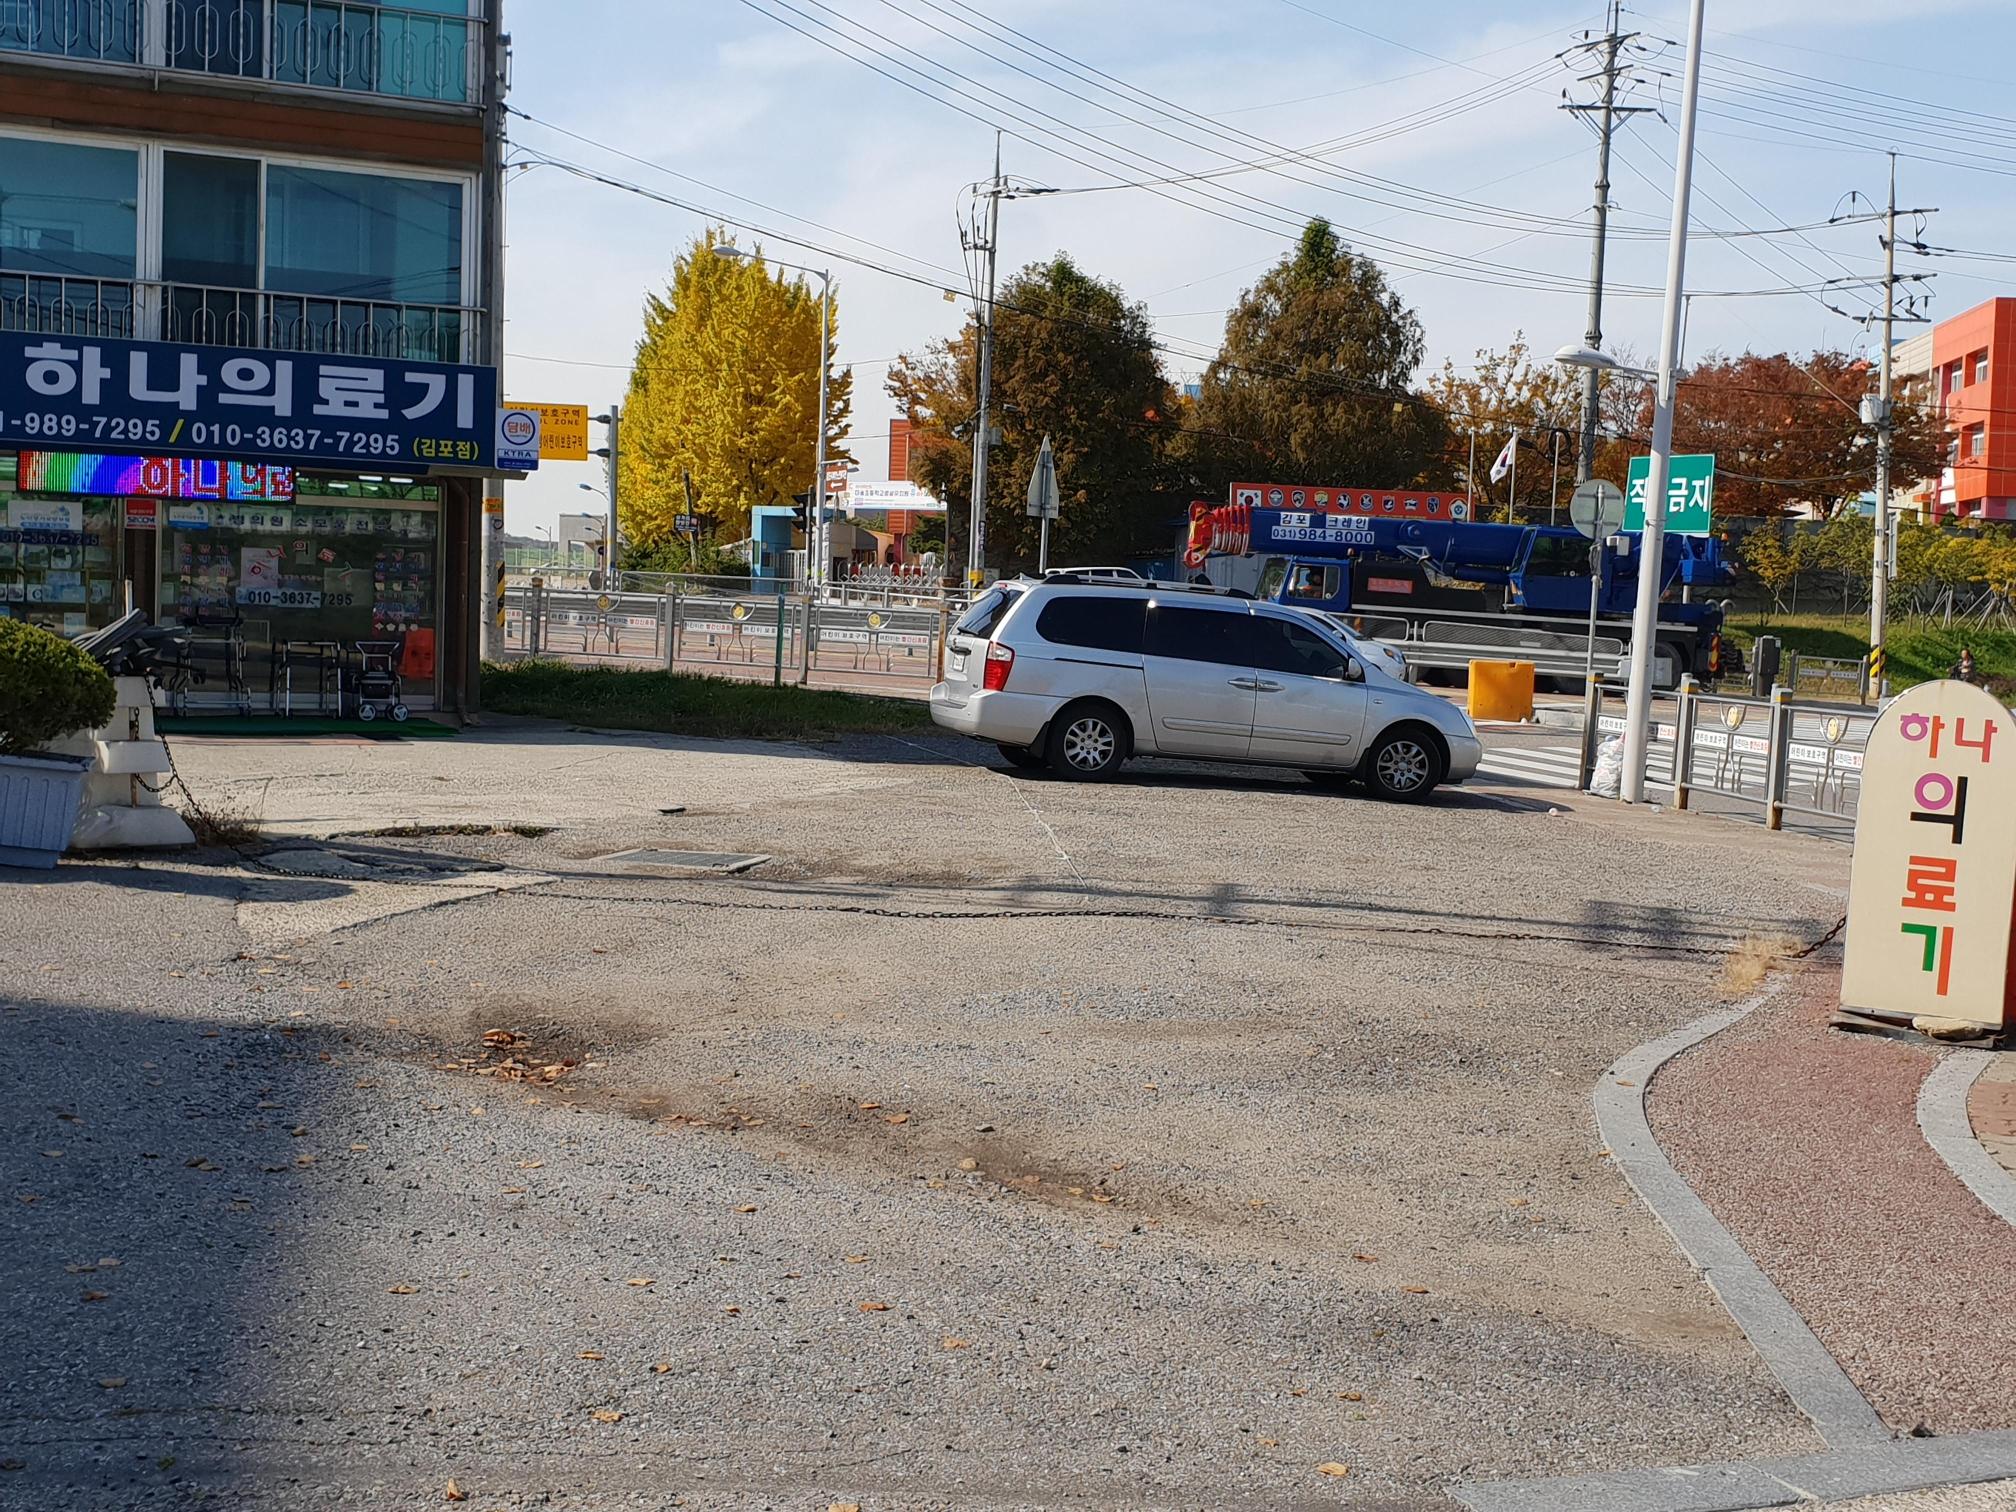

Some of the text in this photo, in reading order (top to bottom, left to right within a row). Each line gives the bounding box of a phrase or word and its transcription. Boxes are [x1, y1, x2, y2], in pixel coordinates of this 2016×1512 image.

[24, 342, 474, 429] 하나의료기
[507, 421, 531, 434] 담배
[554, 418, 579, 426] ZONE
[191, 422, 399, 455] 010-3637-7295
[413, 437, 479, 461] (김포점)
[1629, 475, 1711, 513] 직금지
[1282, 513, 1309, 526] 김포
[1327, 516, 1368, 530] 크레인
[1272, 528, 1374, 544] 031)984-8000
[1900, 713, 1998, 763] 하나
